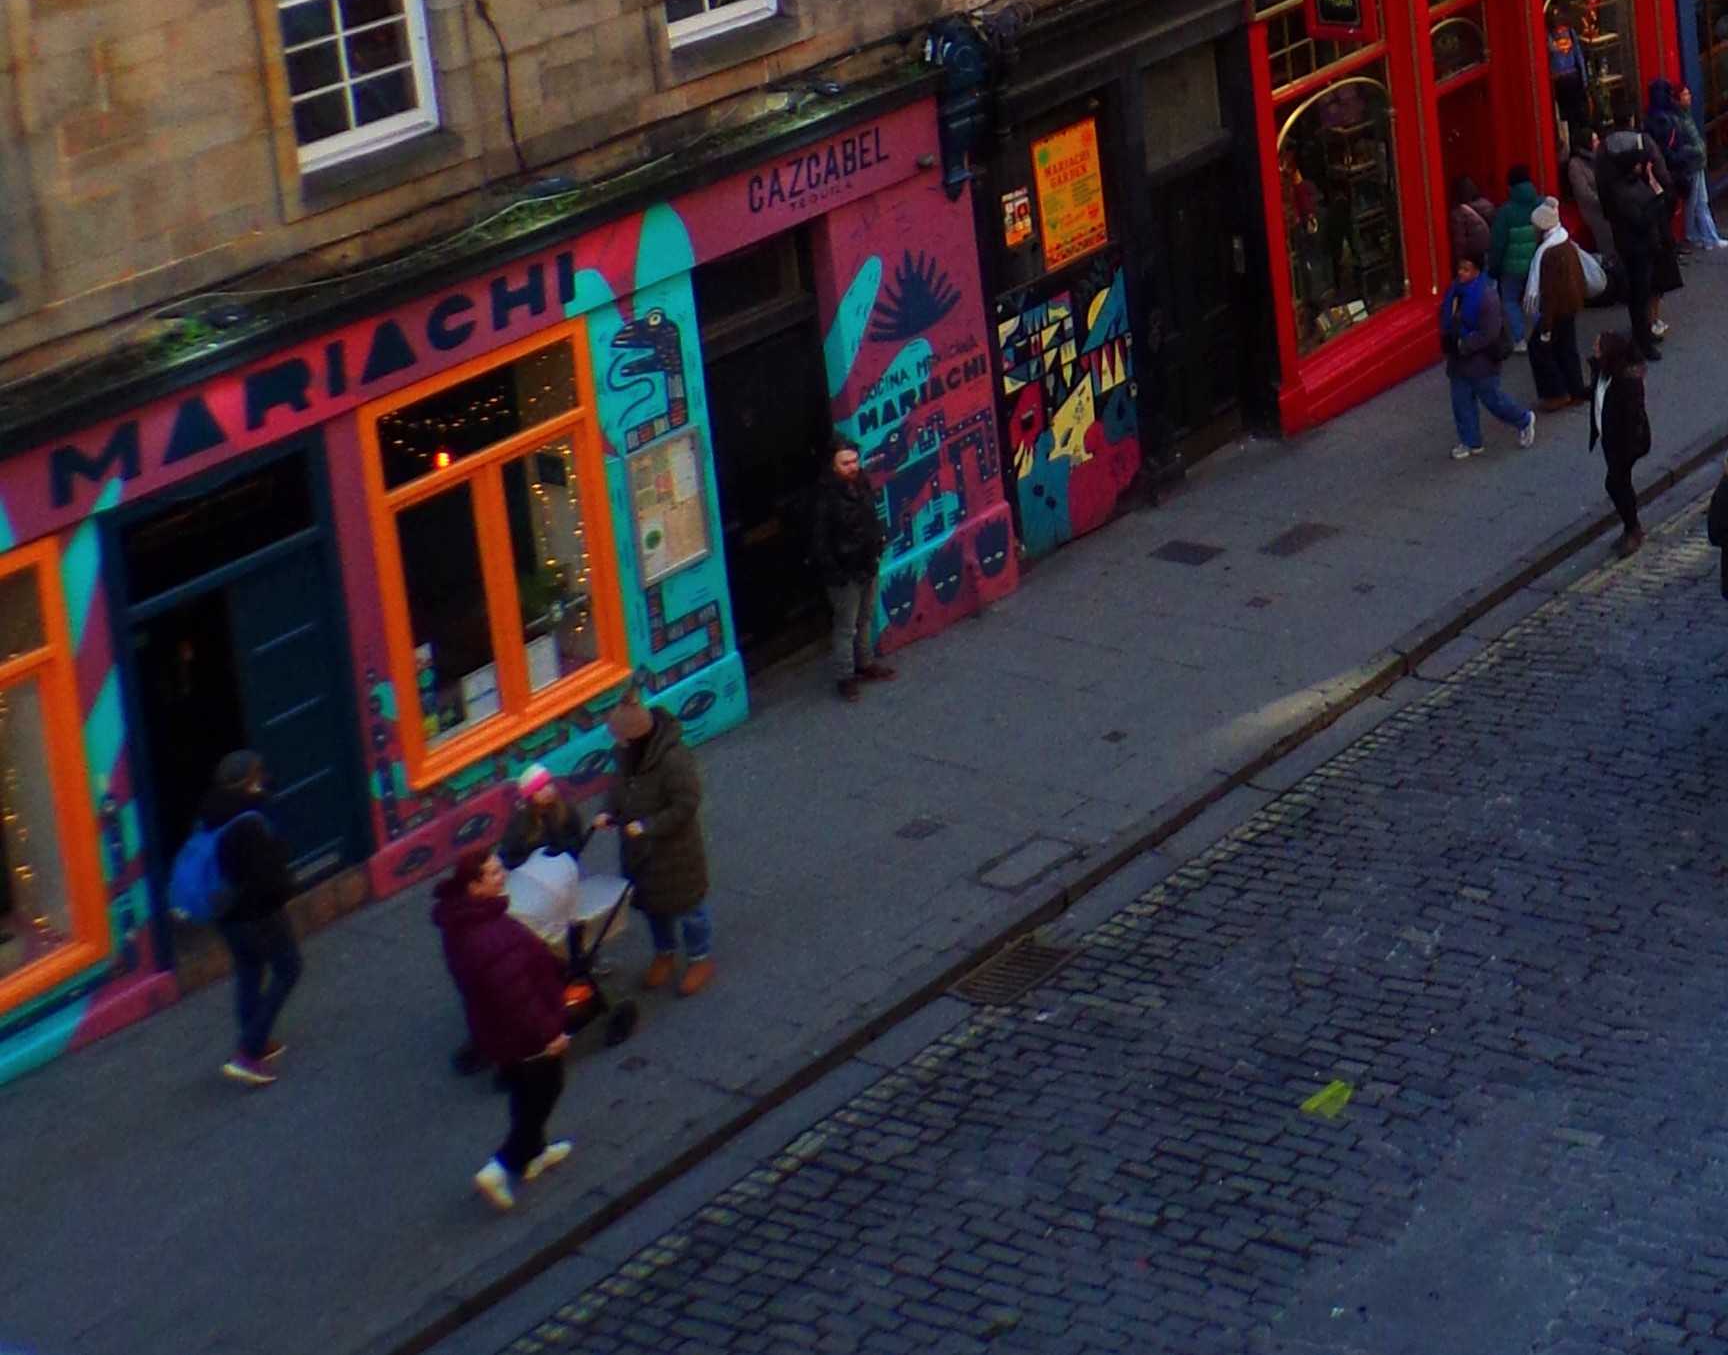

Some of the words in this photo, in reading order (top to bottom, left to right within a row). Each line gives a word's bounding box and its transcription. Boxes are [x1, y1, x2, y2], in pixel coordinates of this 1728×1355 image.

[747, 125, 891, 214] CAZCABEL
[50, 251, 577, 507] MARIACHI
[857, 352, 987, 437] MARIACHI
